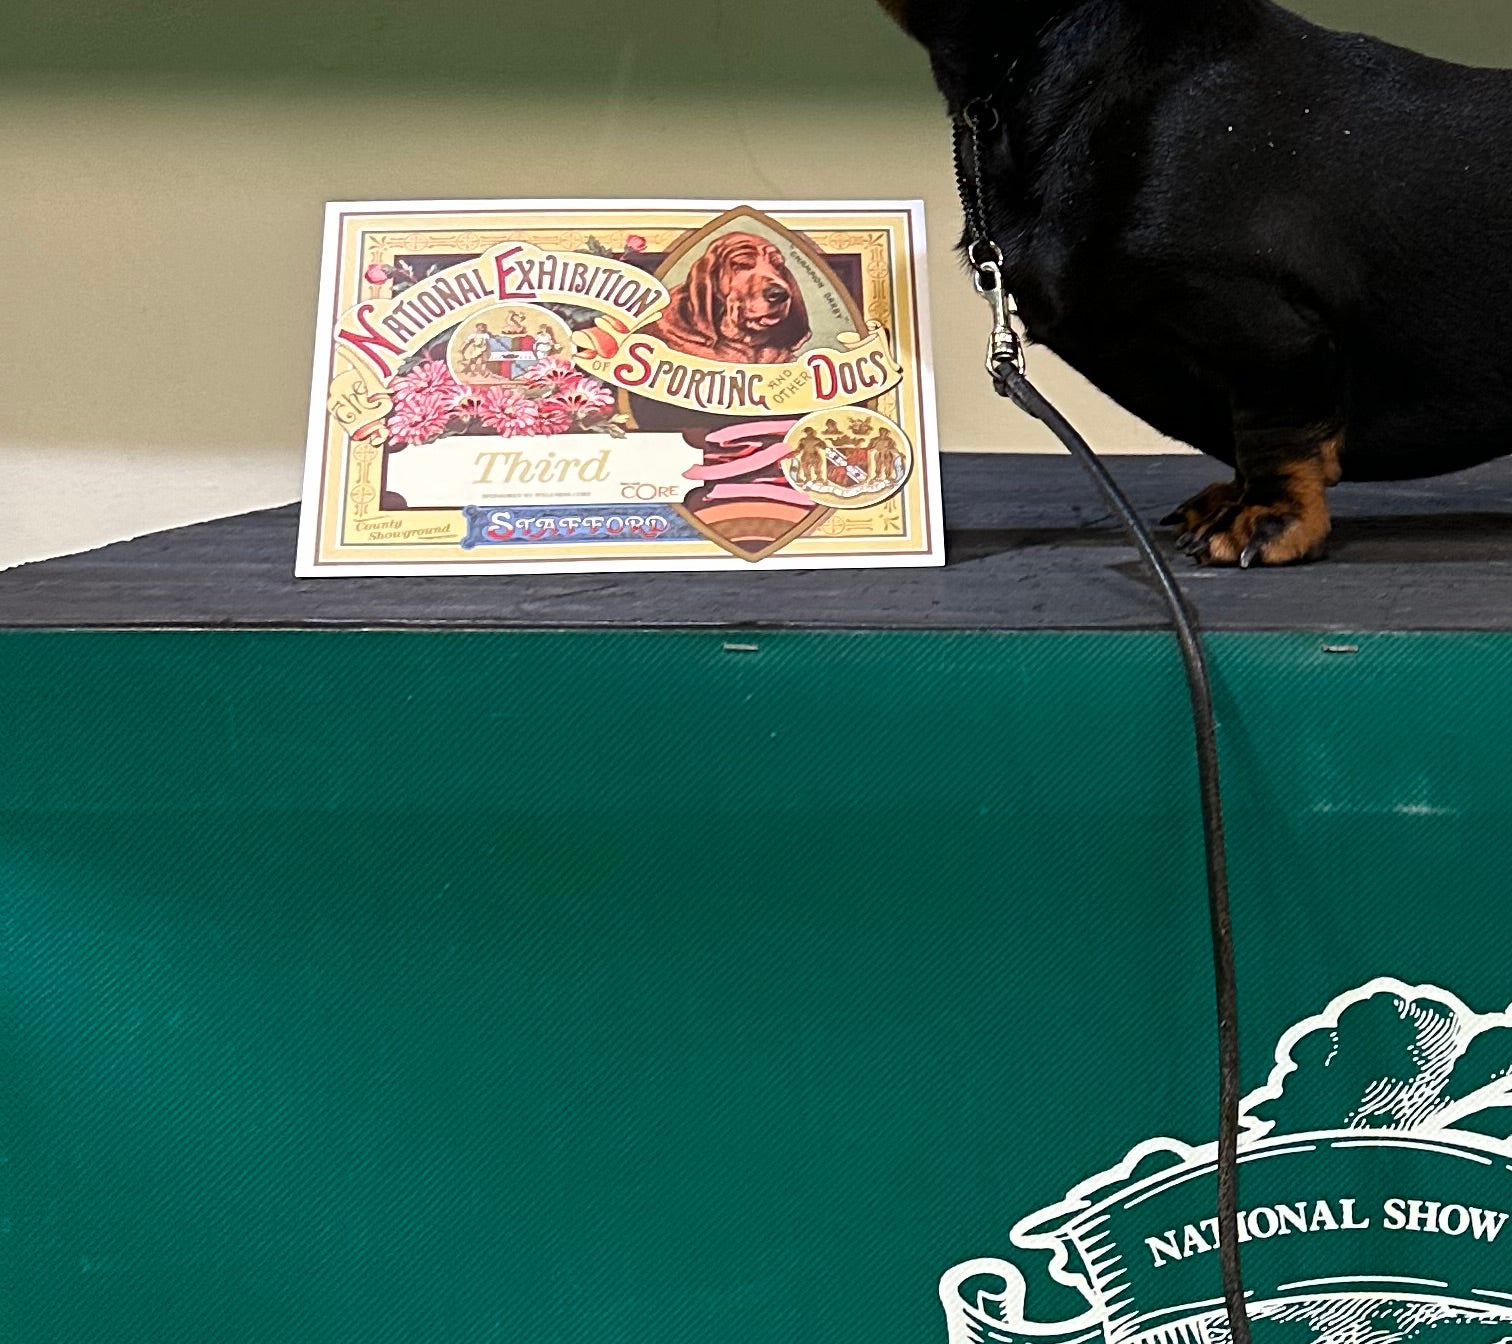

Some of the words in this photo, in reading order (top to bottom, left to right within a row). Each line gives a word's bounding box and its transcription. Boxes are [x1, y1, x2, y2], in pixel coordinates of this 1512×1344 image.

[338, 268, 495, 379] NATIONAL
[495, 245, 662, 318] EXHIBITION
[592, 360, 610, 372] OF
[613, 342, 772, 411] SPORTING
[768, 369, 793, 390] AND
[772, 371, 812, 404] OTHER
[807, 350, 886, 401] DOGS
[331, 380, 382, 424] The
[472, 449, 612, 485] Third
[621, 483, 680, 501] CORE
[355, 520, 403, 531] County
[368, 524, 451, 541] Showground
[487, 511, 667, 541] STAFFORD
[1383, 1198, 1510, 1242] SHOW
